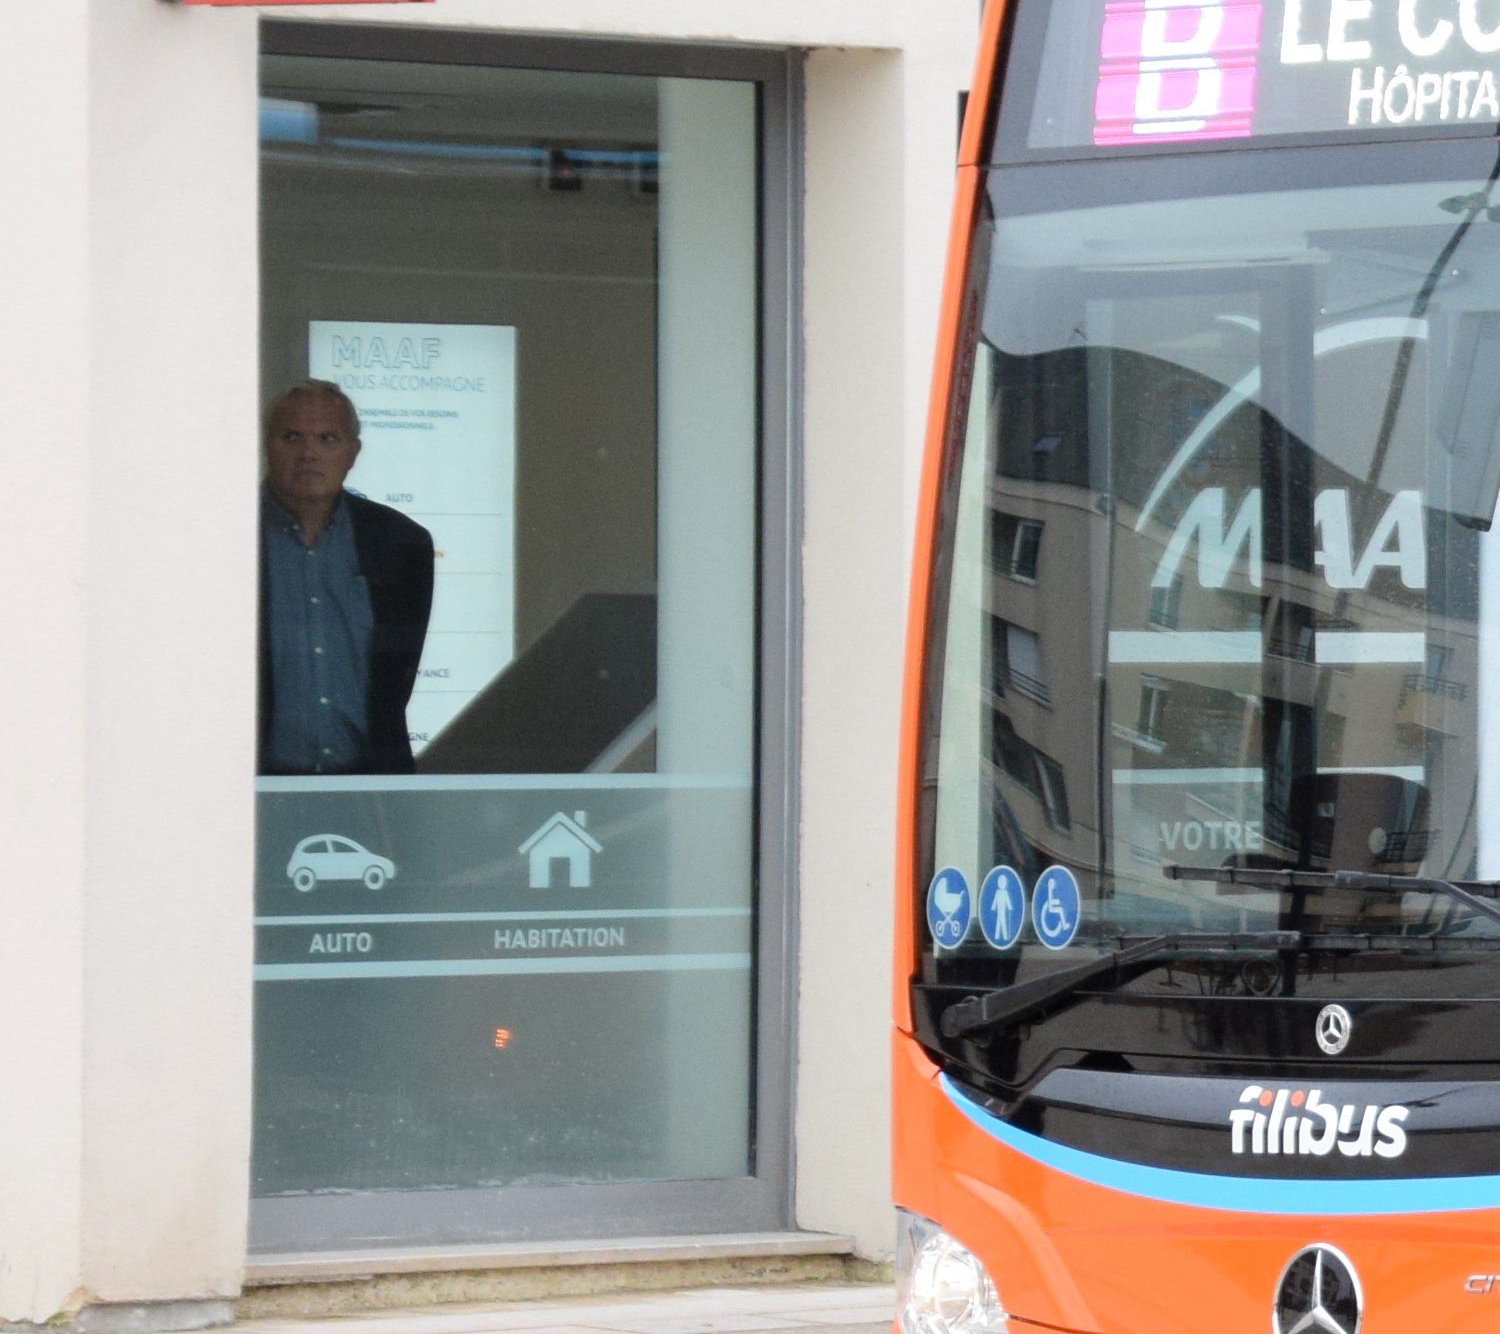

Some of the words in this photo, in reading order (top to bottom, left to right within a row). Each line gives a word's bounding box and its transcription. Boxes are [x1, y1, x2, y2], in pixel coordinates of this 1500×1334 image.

[331, 334, 440, 369] MAAF
[332, 372, 376, 390] VOUS
[381, 374, 487, 393] ACCOMPAGNE
[385, 493, 413, 503] AUTO
[1160, 821, 1264, 851] VOTRE
[309, 932, 372, 953] AUTO
[494, 926, 625, 949] HABITATION
[1229, 1085, 1410, 1158] filibus
